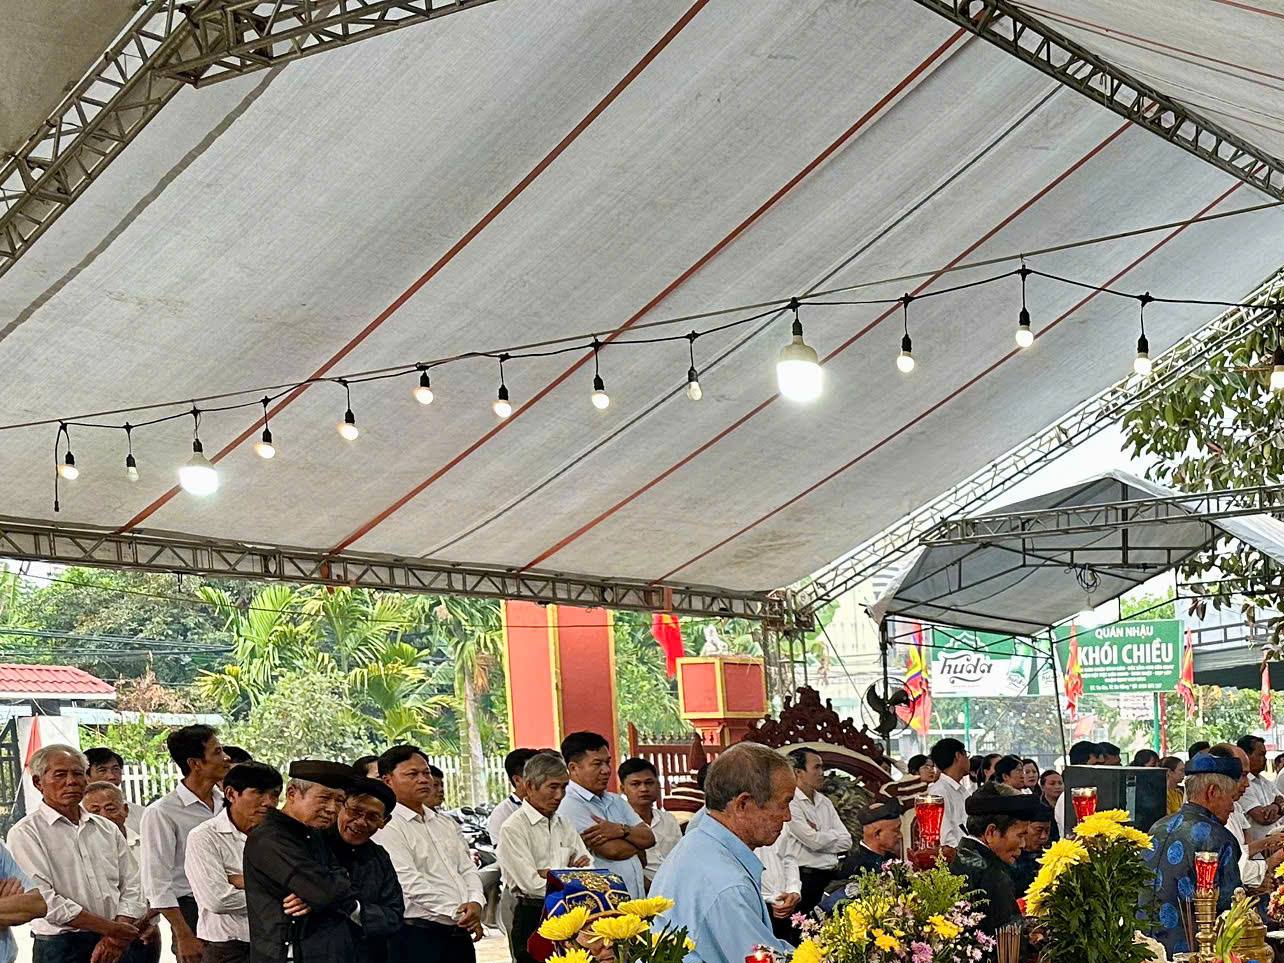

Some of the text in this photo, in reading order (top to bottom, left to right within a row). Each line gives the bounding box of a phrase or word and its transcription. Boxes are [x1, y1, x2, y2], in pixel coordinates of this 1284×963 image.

[1095, 623, 1153, 639] QUÁN NHẬU
[1078, 642, 1118, 666] KHÓI
